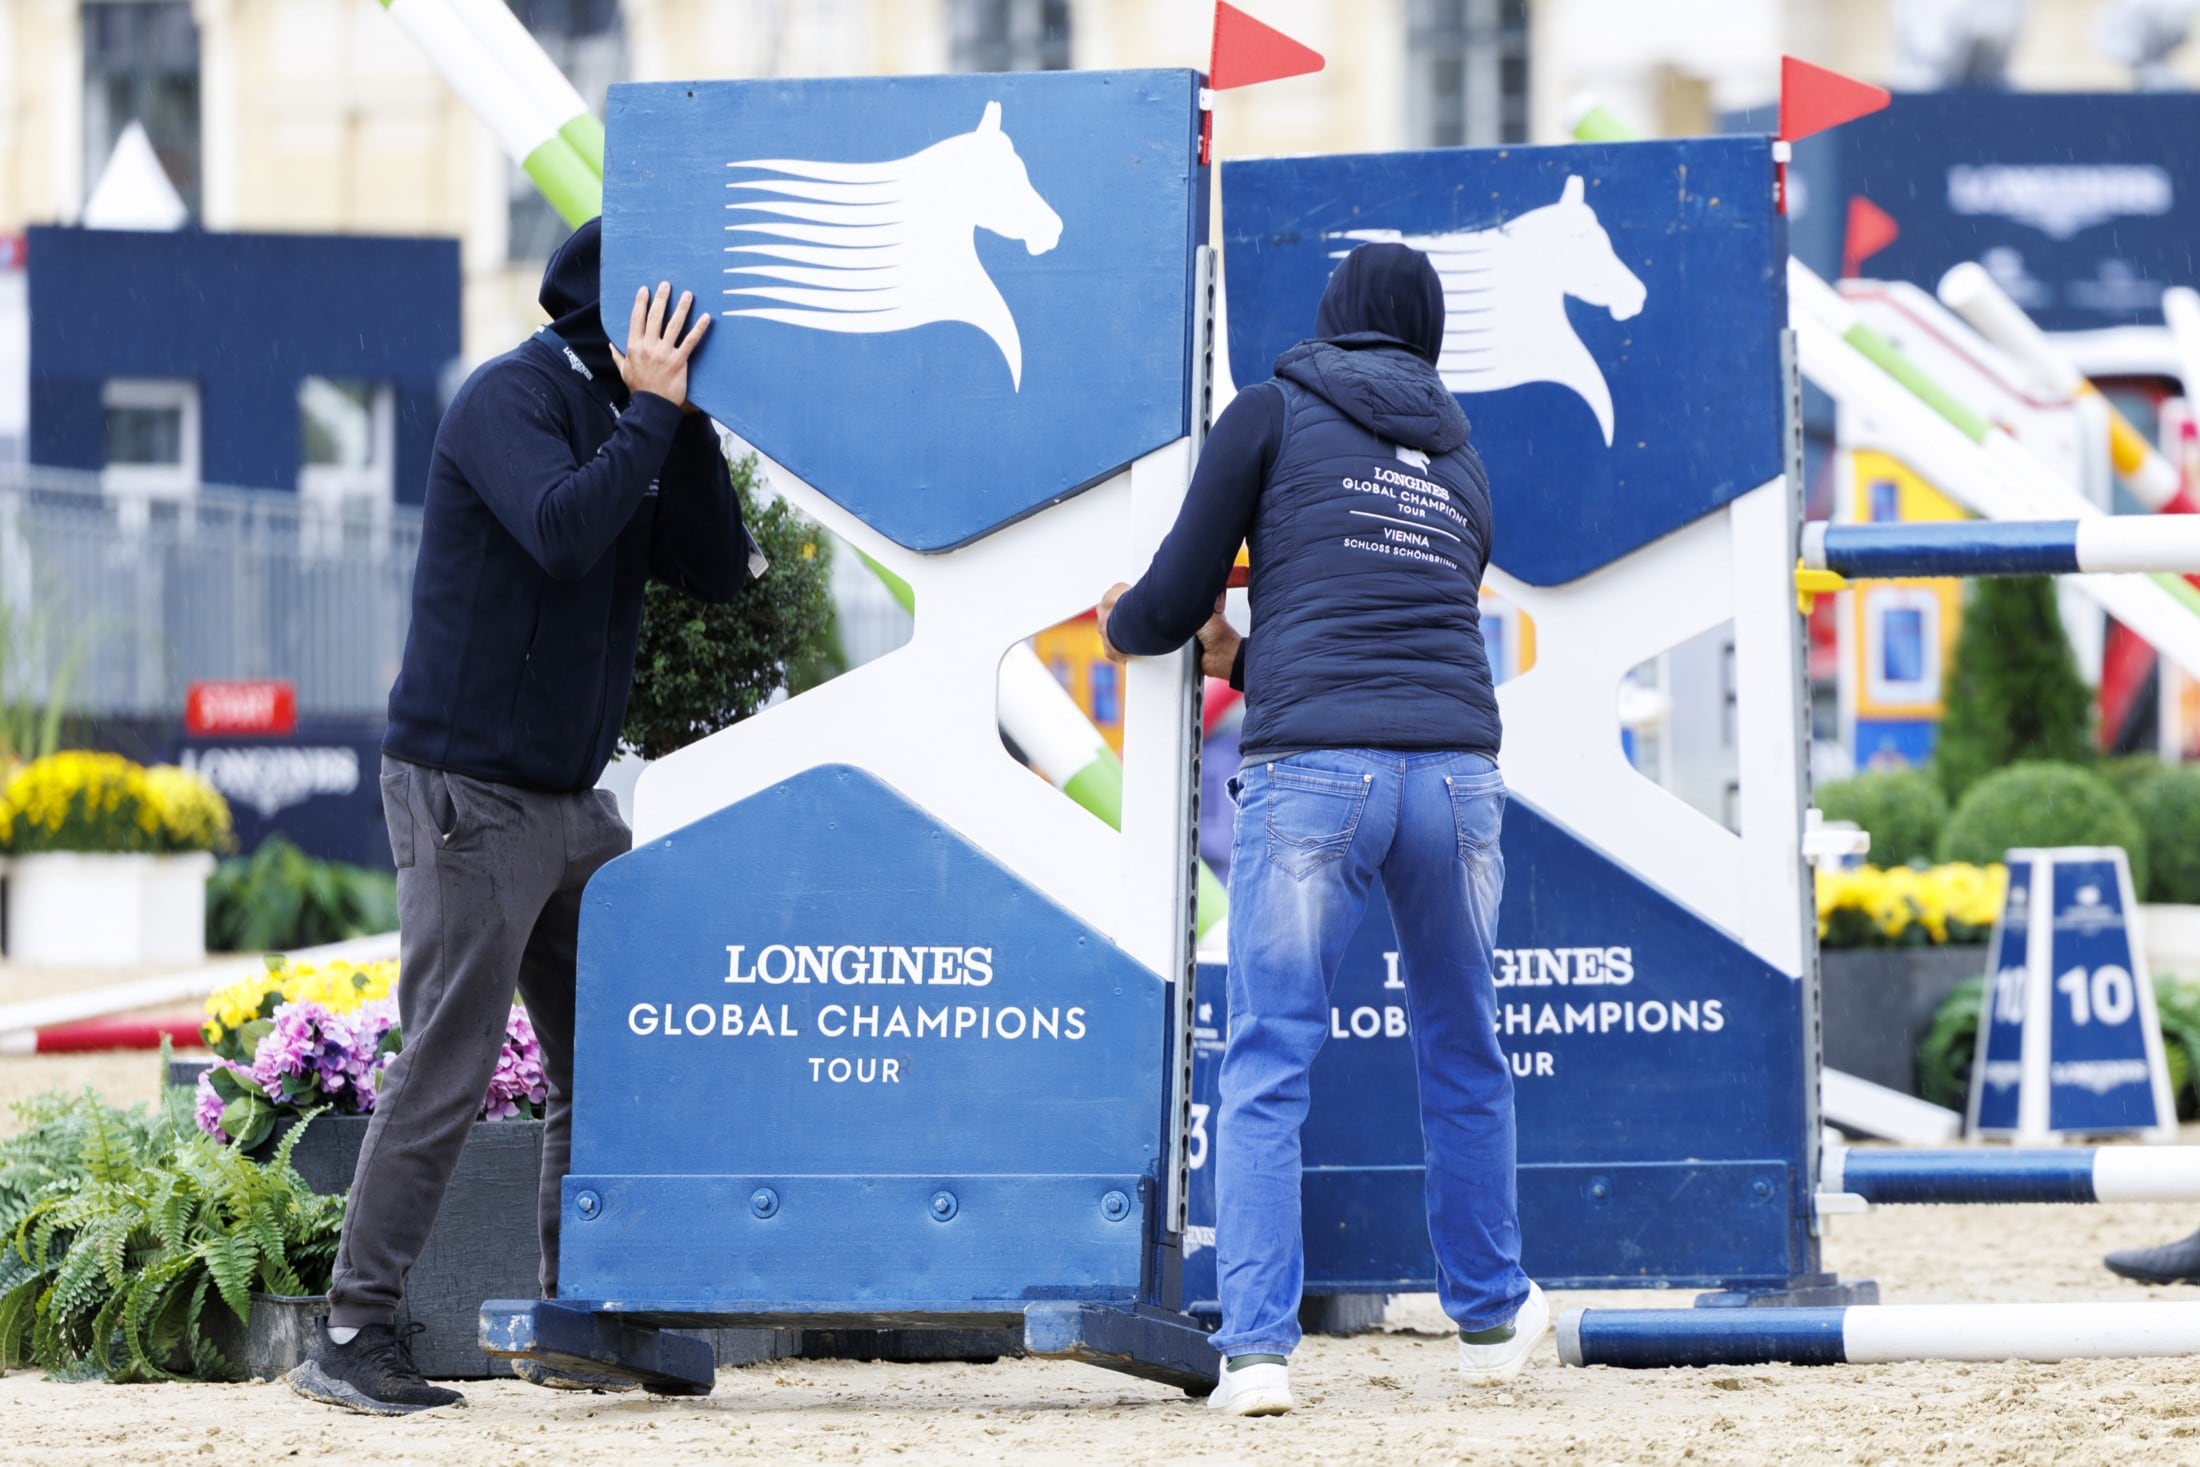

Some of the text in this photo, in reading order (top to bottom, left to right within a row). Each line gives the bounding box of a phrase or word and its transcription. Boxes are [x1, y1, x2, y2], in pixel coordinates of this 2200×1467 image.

[1343, 478, 1397, 499] GLOBAL
[1374, 467, 1450, 501] LONGINES
[1398, 504, 1426, 518] TOUR
[1344, 538, 1390, 554] SCHLOSS
[1384, 528, 1429, 548] VIENNA
[724, 944, 994, 987] LONGINES
[1383, 947, 1634, 988] LGINES
[2057, 964, 2135, 1026] 10
[628, 1003, 1087, 1040] GLOBAL CHAMPIONS
[808, 1057, 900, 1083] TOUR
